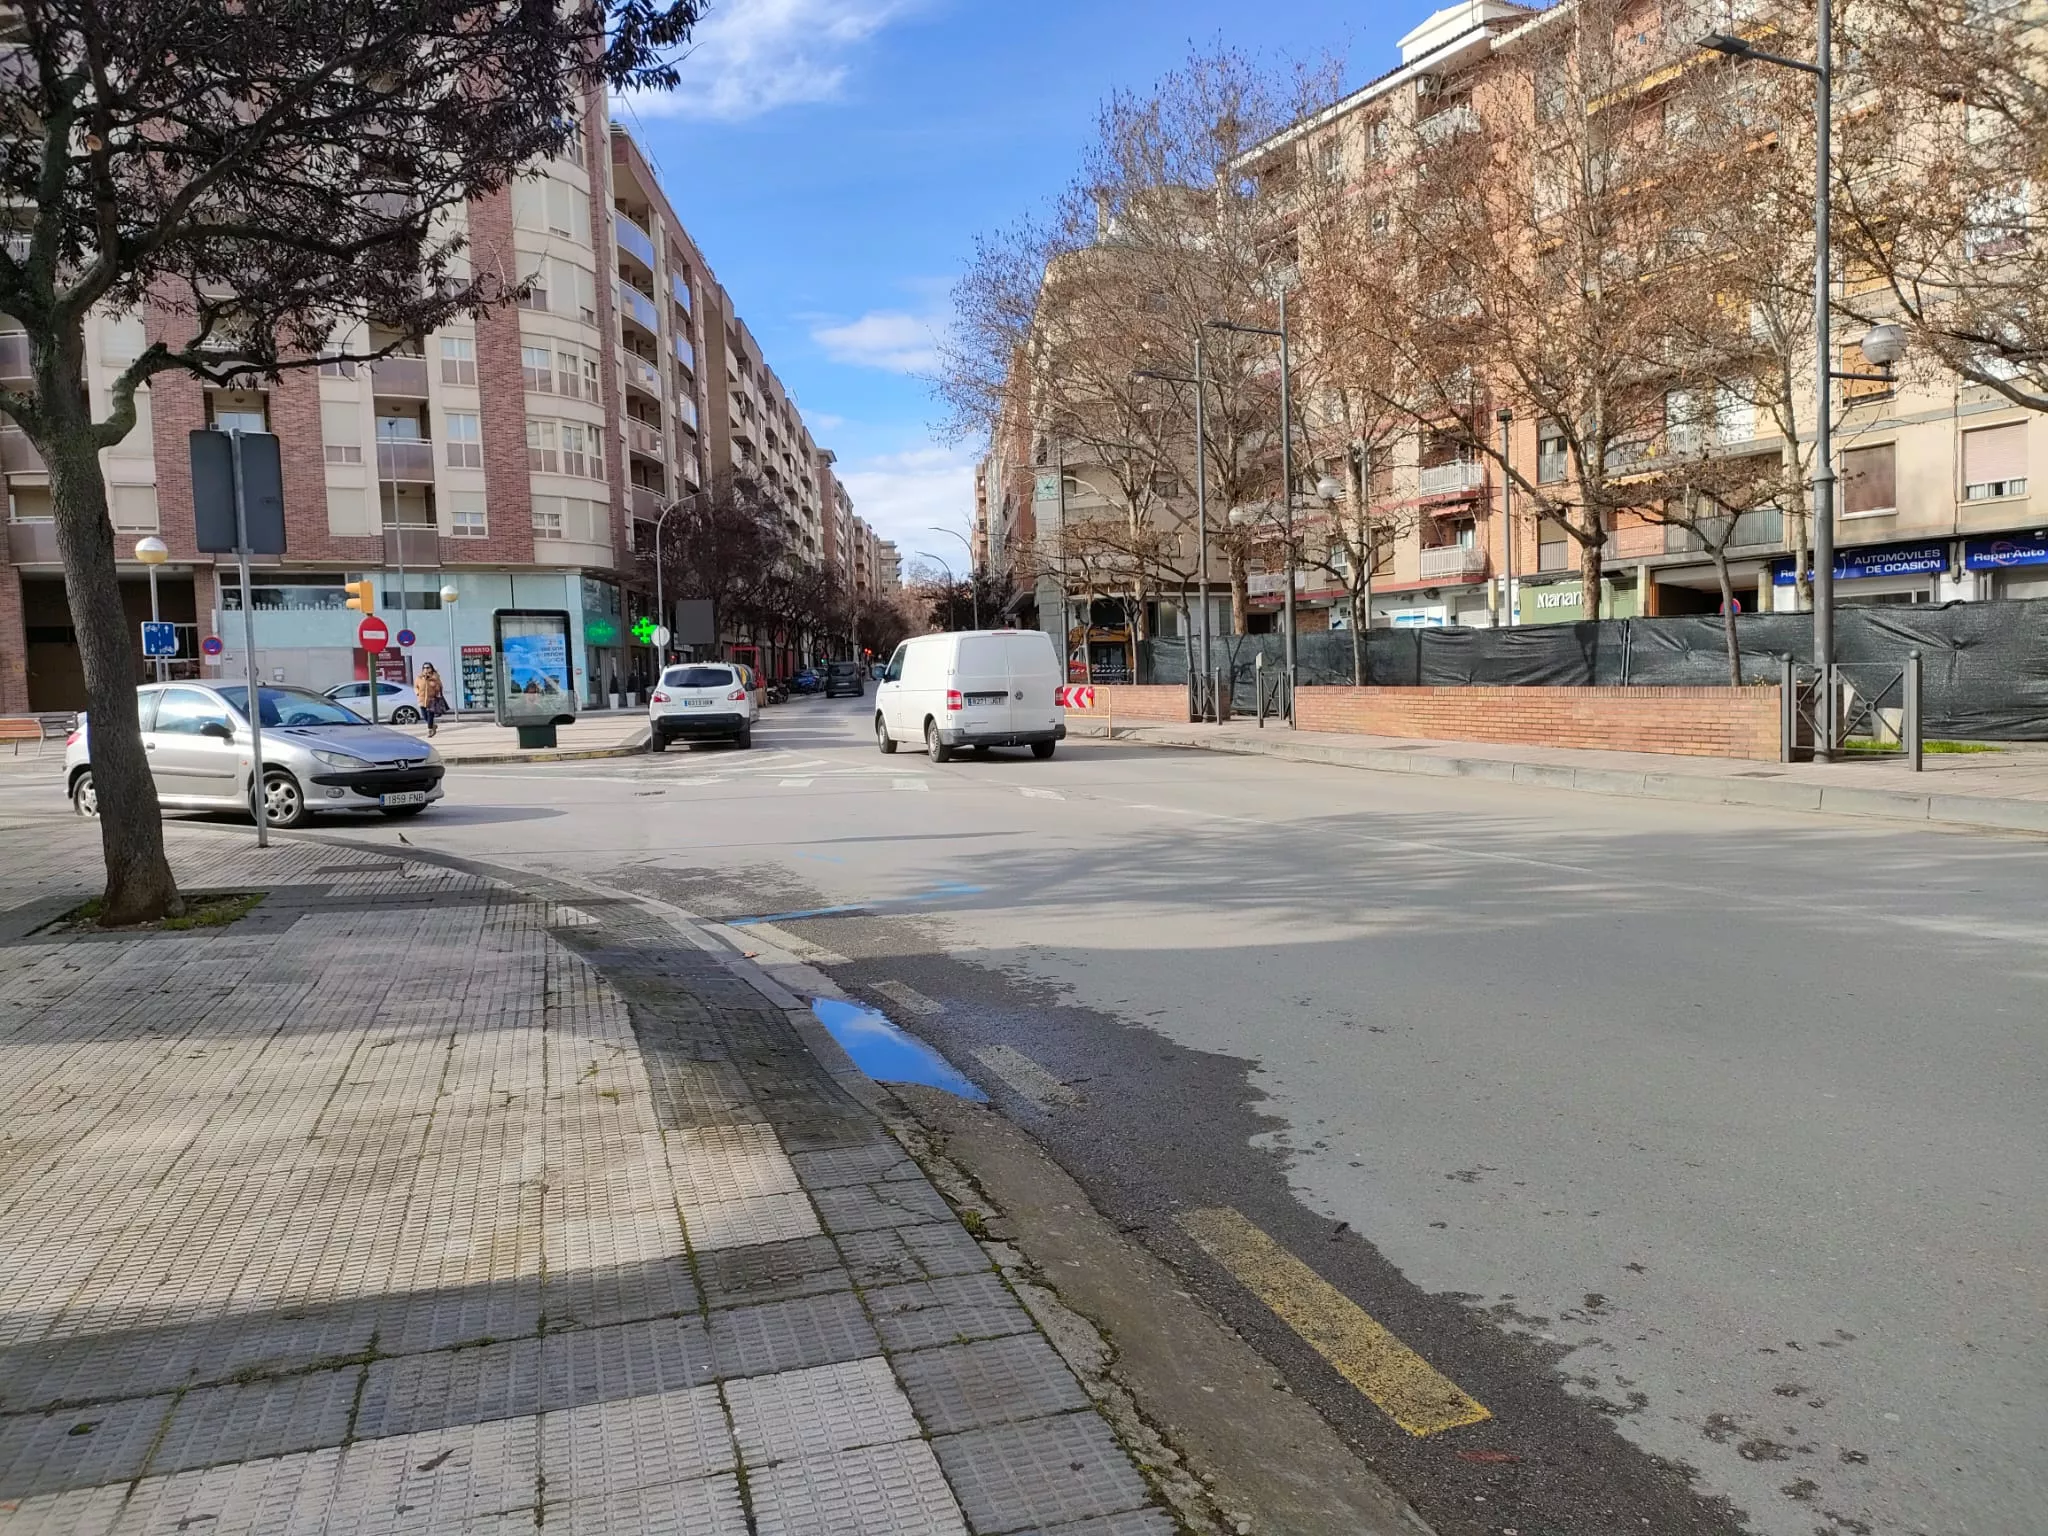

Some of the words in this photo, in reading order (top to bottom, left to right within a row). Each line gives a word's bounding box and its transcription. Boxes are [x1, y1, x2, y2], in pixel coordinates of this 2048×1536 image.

[1854, 549, 1941, 565] AUTOMÓVILES
[1974, 549, 2046, 563] ReparAuto
[1866, 565, 1882, 574] DE
[1884, 559, 1941, 573] OCASIÓN
[388, 793, 406, 804] 1859
[409, 792, 424, 803] FNB
